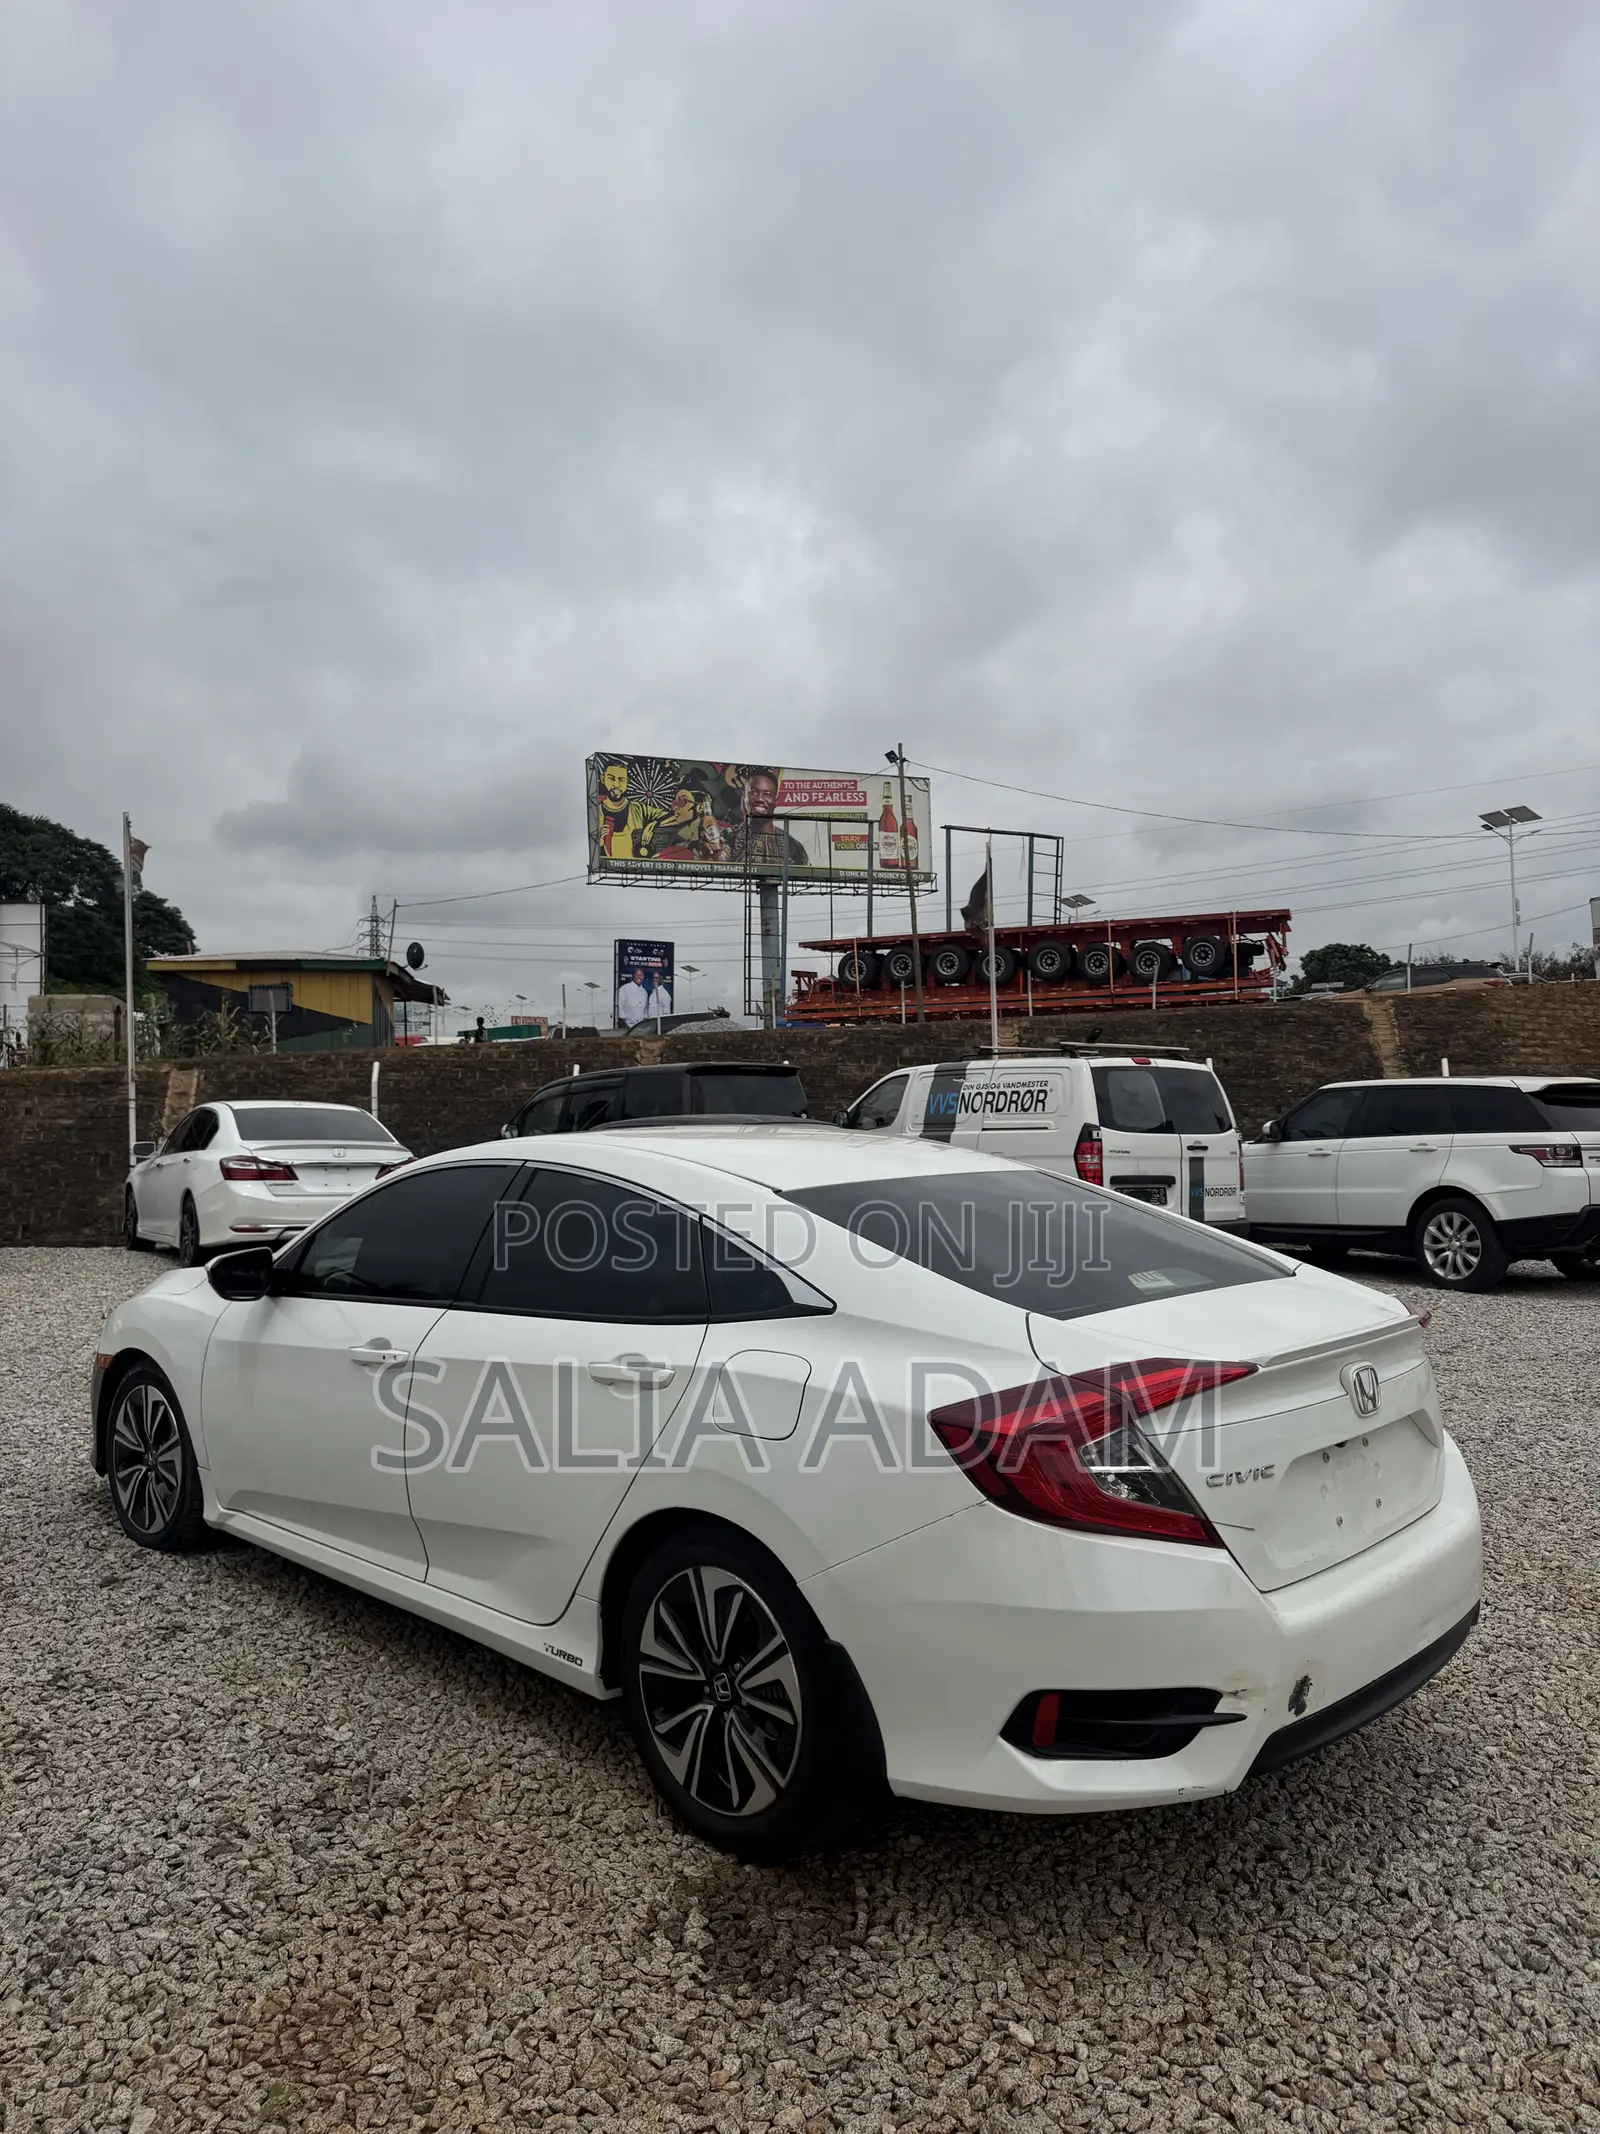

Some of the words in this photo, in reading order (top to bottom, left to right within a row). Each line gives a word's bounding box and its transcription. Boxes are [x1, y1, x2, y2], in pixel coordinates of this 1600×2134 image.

[783, 781, 795, 789] TO
[796, 781, 811, 789] THE
[811, 781, 856, 790] AUTHENTIC
[784, 792, 810, 803] AND
[811, 792, 865, 802] FEARLESS
[962, 1083, 975, 1091] DIN
[1002, 1080, 1049, 1089] VANDMESTER
[928, 1092, 958, 1115] VVS
[958, 1088, 1048, 1114] NORDRØR
[1205, 1463, 1276, 1489] CIVIC
[543, 1641, 584, 1668] TURBO
